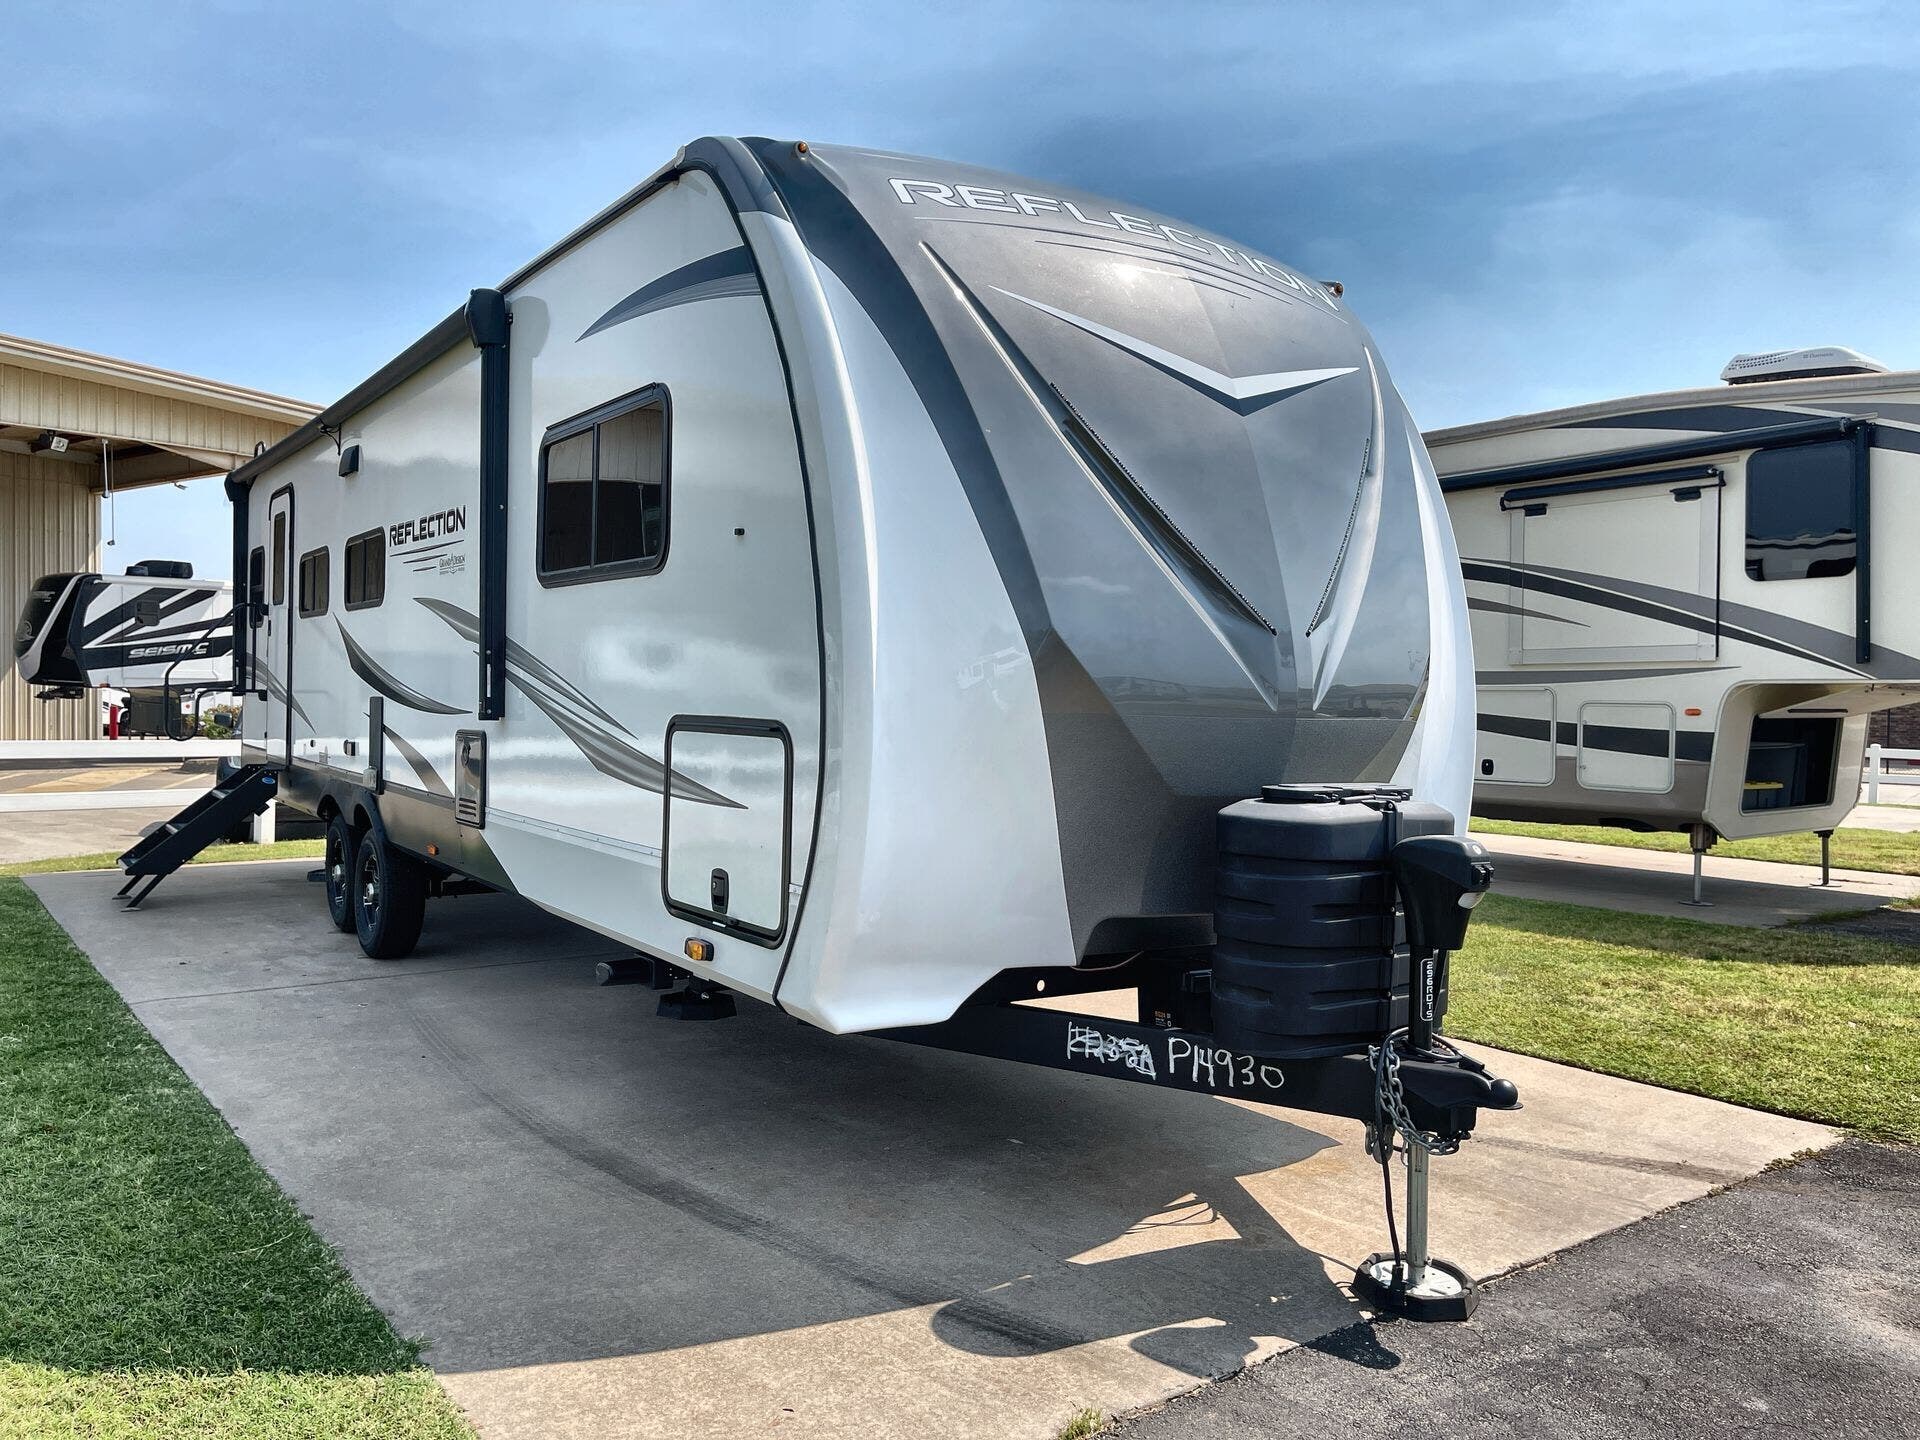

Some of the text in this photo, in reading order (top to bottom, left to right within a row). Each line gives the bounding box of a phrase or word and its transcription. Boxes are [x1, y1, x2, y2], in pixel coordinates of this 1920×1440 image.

[888, 177, 1339, 311] REFLECTION
[389, 505, 466, 547] REFLECTION
[128, 642, 209, 658] SEISMC
[1168, 1036, 1285, 1089] P14930
